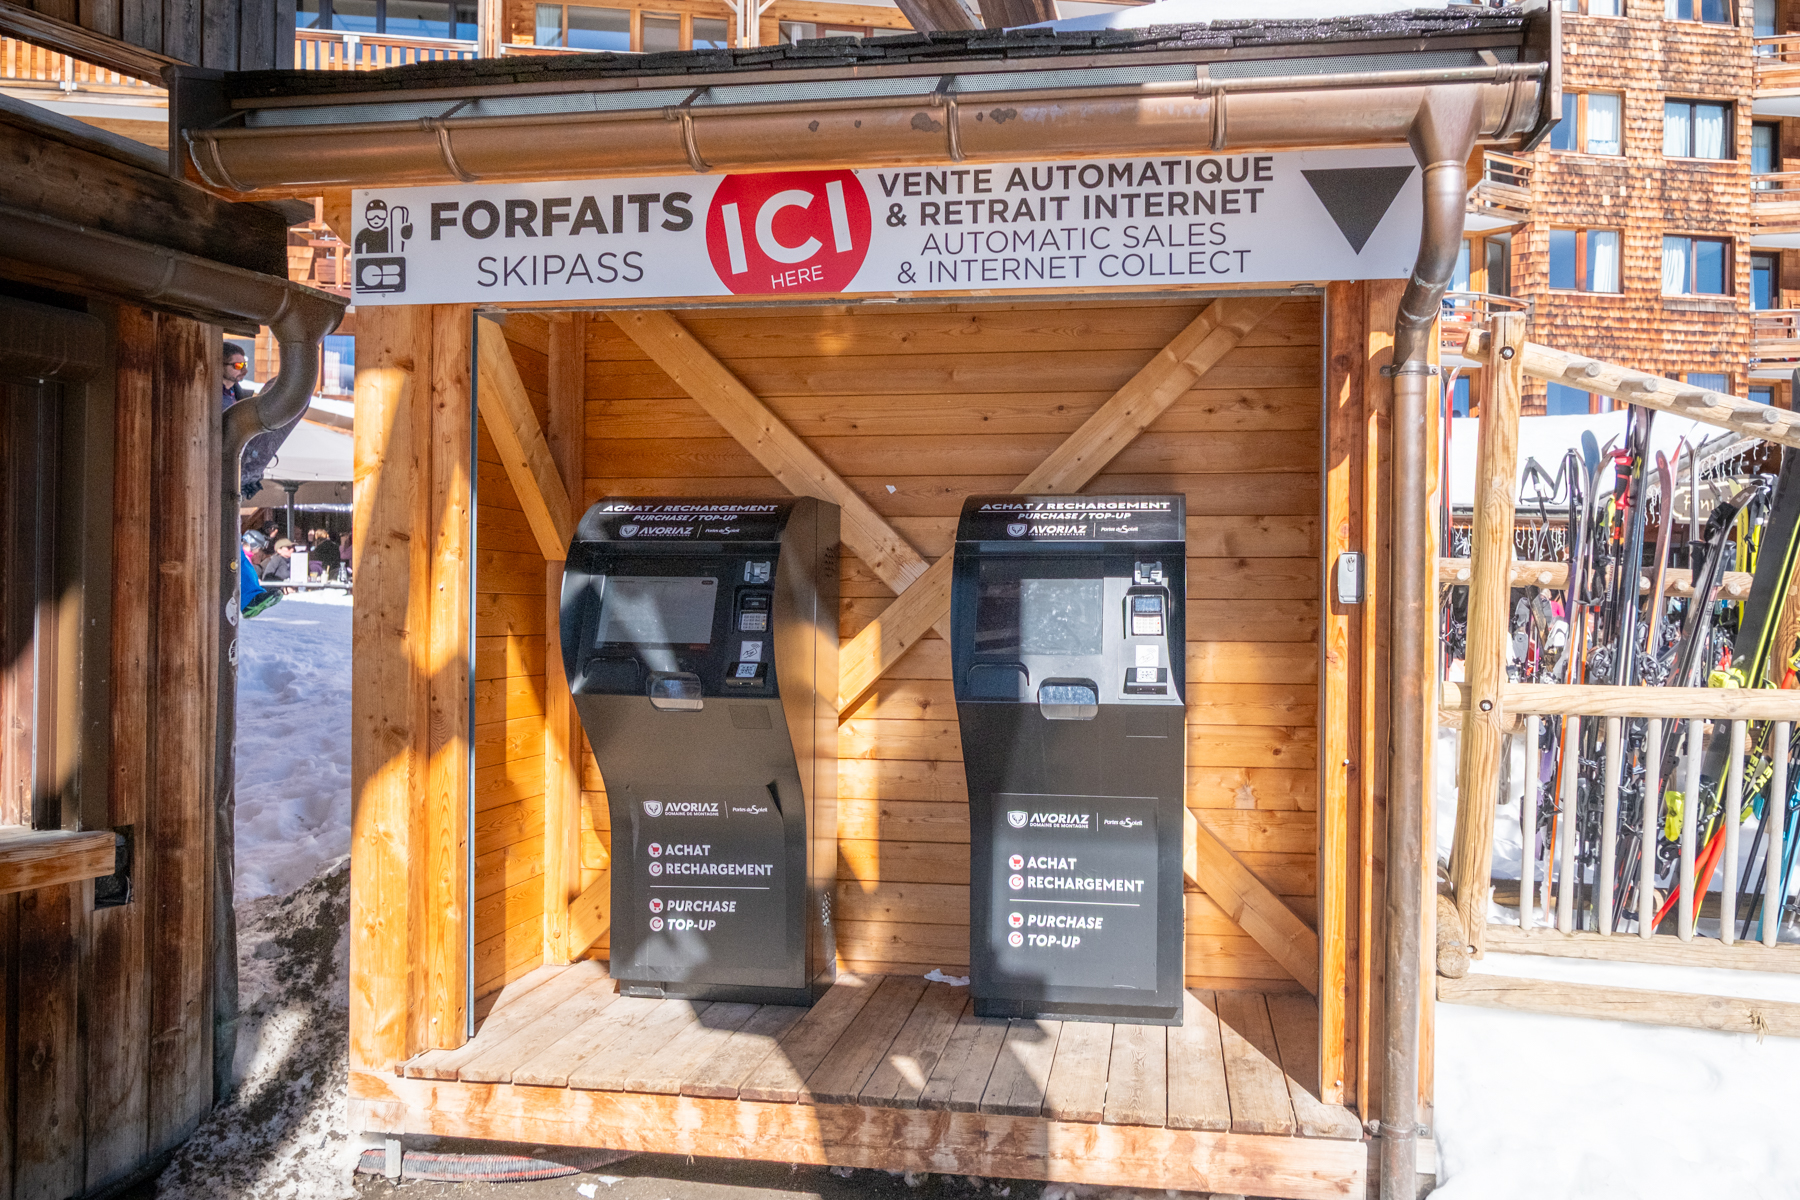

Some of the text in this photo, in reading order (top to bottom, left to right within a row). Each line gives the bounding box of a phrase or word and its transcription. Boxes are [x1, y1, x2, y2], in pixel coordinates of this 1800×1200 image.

[878, 156, 1274, 198] VENTE AUTOMATIQUE
[885, 187, 1265, 227] & RETRAIT INTERNET
[430, 191, 693, 242] FORFAITS
[721, 179, 854, 275] ICI
[920, 222, 1227, 257] AUTOMATIC SALES
[476, 251, 645, 288] SKIPASS
[897, 249, 1252, 284] & INTERNET COLLECT
[770, 265, 825, 290] HERE
[1046, 502, 1171, 510] RECHARGEMENT
[1017, 512, 1078, 520] PURCHASE
[1088, 512, 1132, 520] TOP-UP
[638, 526, 694, 535] AVORIAZ
[1028, 525, 1088, 534] AVORIAZ
[1744, 745, 1764, 783] LEKI
[1752, 761, 1774, 794] EKI
[664, 802, 719, 812] AVORIAZ
[1029, 812, 1090, 824] AVORIAZ
[665, 844, 711, 856] ACHAT
[665, 863, 774, 876] RECHARGEMENT
[1027, 856, 1077, 870] ACHAT
[1027, 875, 1145, 893] RECHARGEMENT
[667, 900, 737, 913] PURCHASE
[667, 918, 716, 931] TOP-UP
[1027, 914, 1104, 930] PURCHASE
[1027, 933, 1081, 949] TOP-UP
